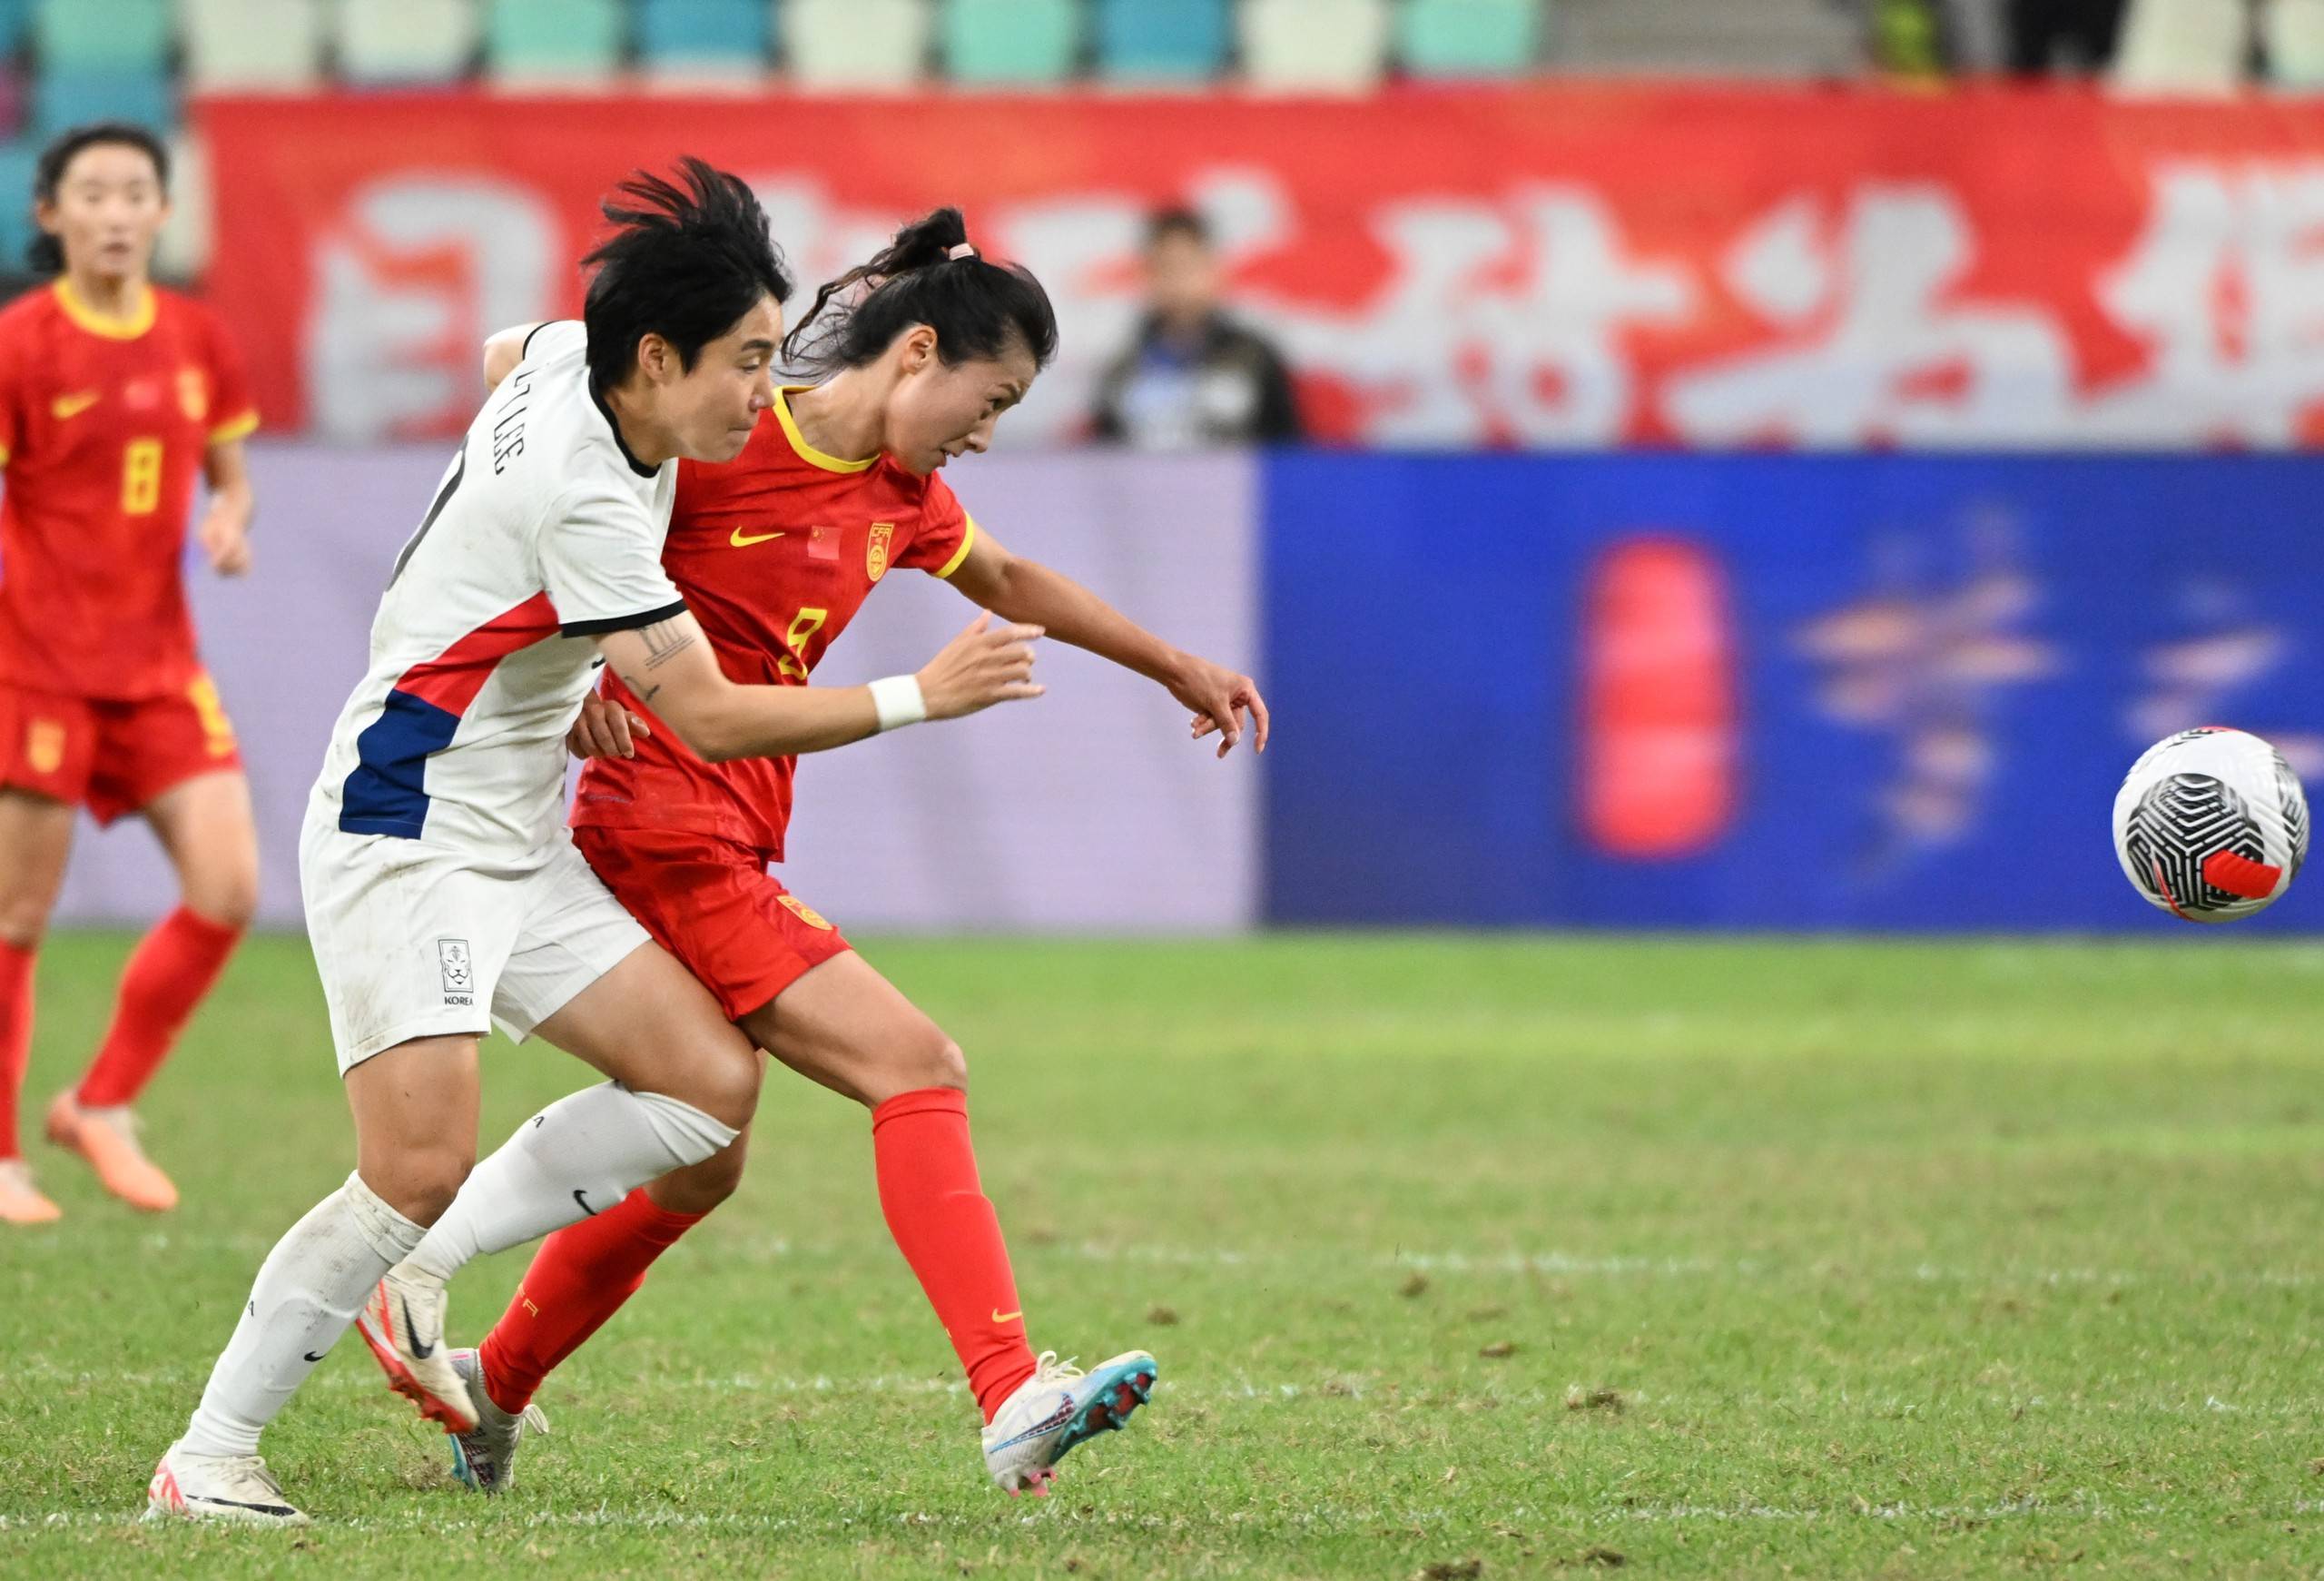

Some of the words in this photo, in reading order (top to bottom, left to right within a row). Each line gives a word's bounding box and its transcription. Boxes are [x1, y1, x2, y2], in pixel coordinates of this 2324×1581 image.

[494, 406, 526, 476] LEE
[121, 438, 163, 516] 8
[778, 607, 828, 680] 9
[444, 996, 474, 1006] KOREA
